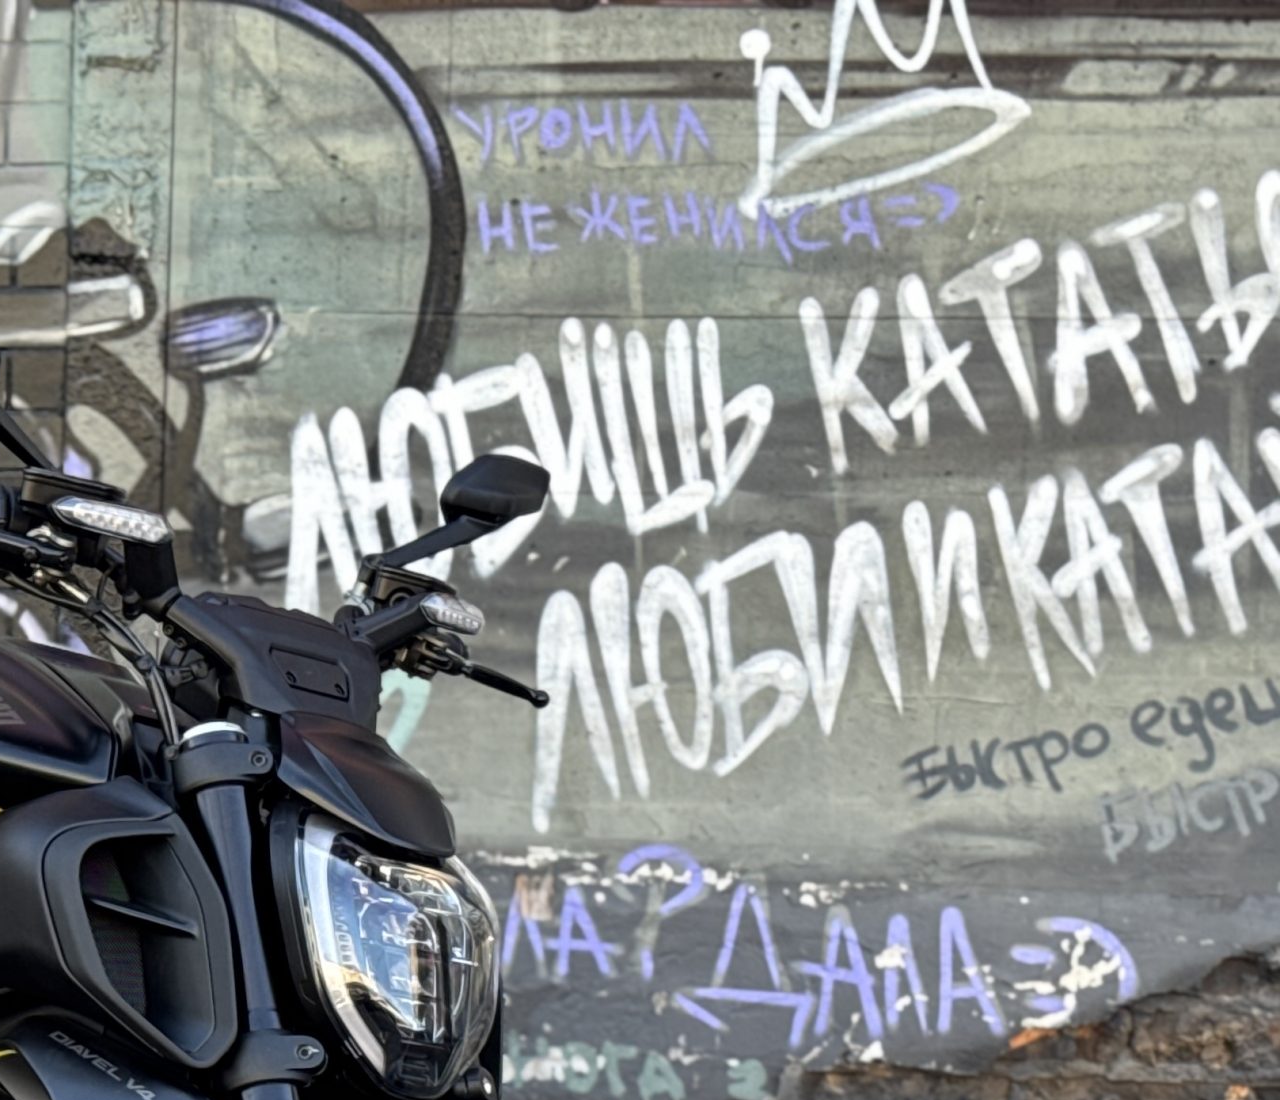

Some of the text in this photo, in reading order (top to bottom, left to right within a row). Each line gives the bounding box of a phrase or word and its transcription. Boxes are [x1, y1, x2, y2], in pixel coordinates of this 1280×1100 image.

[452, 98, 713, 164] УРОНИЛ
[477, 194, 560, 254] НЕ
[799, 170, 1280, 474] КАТАТЬ
[988, 429, 1280, 691] КАТА
[48, 1030, 122, 1082] DIAVEL
